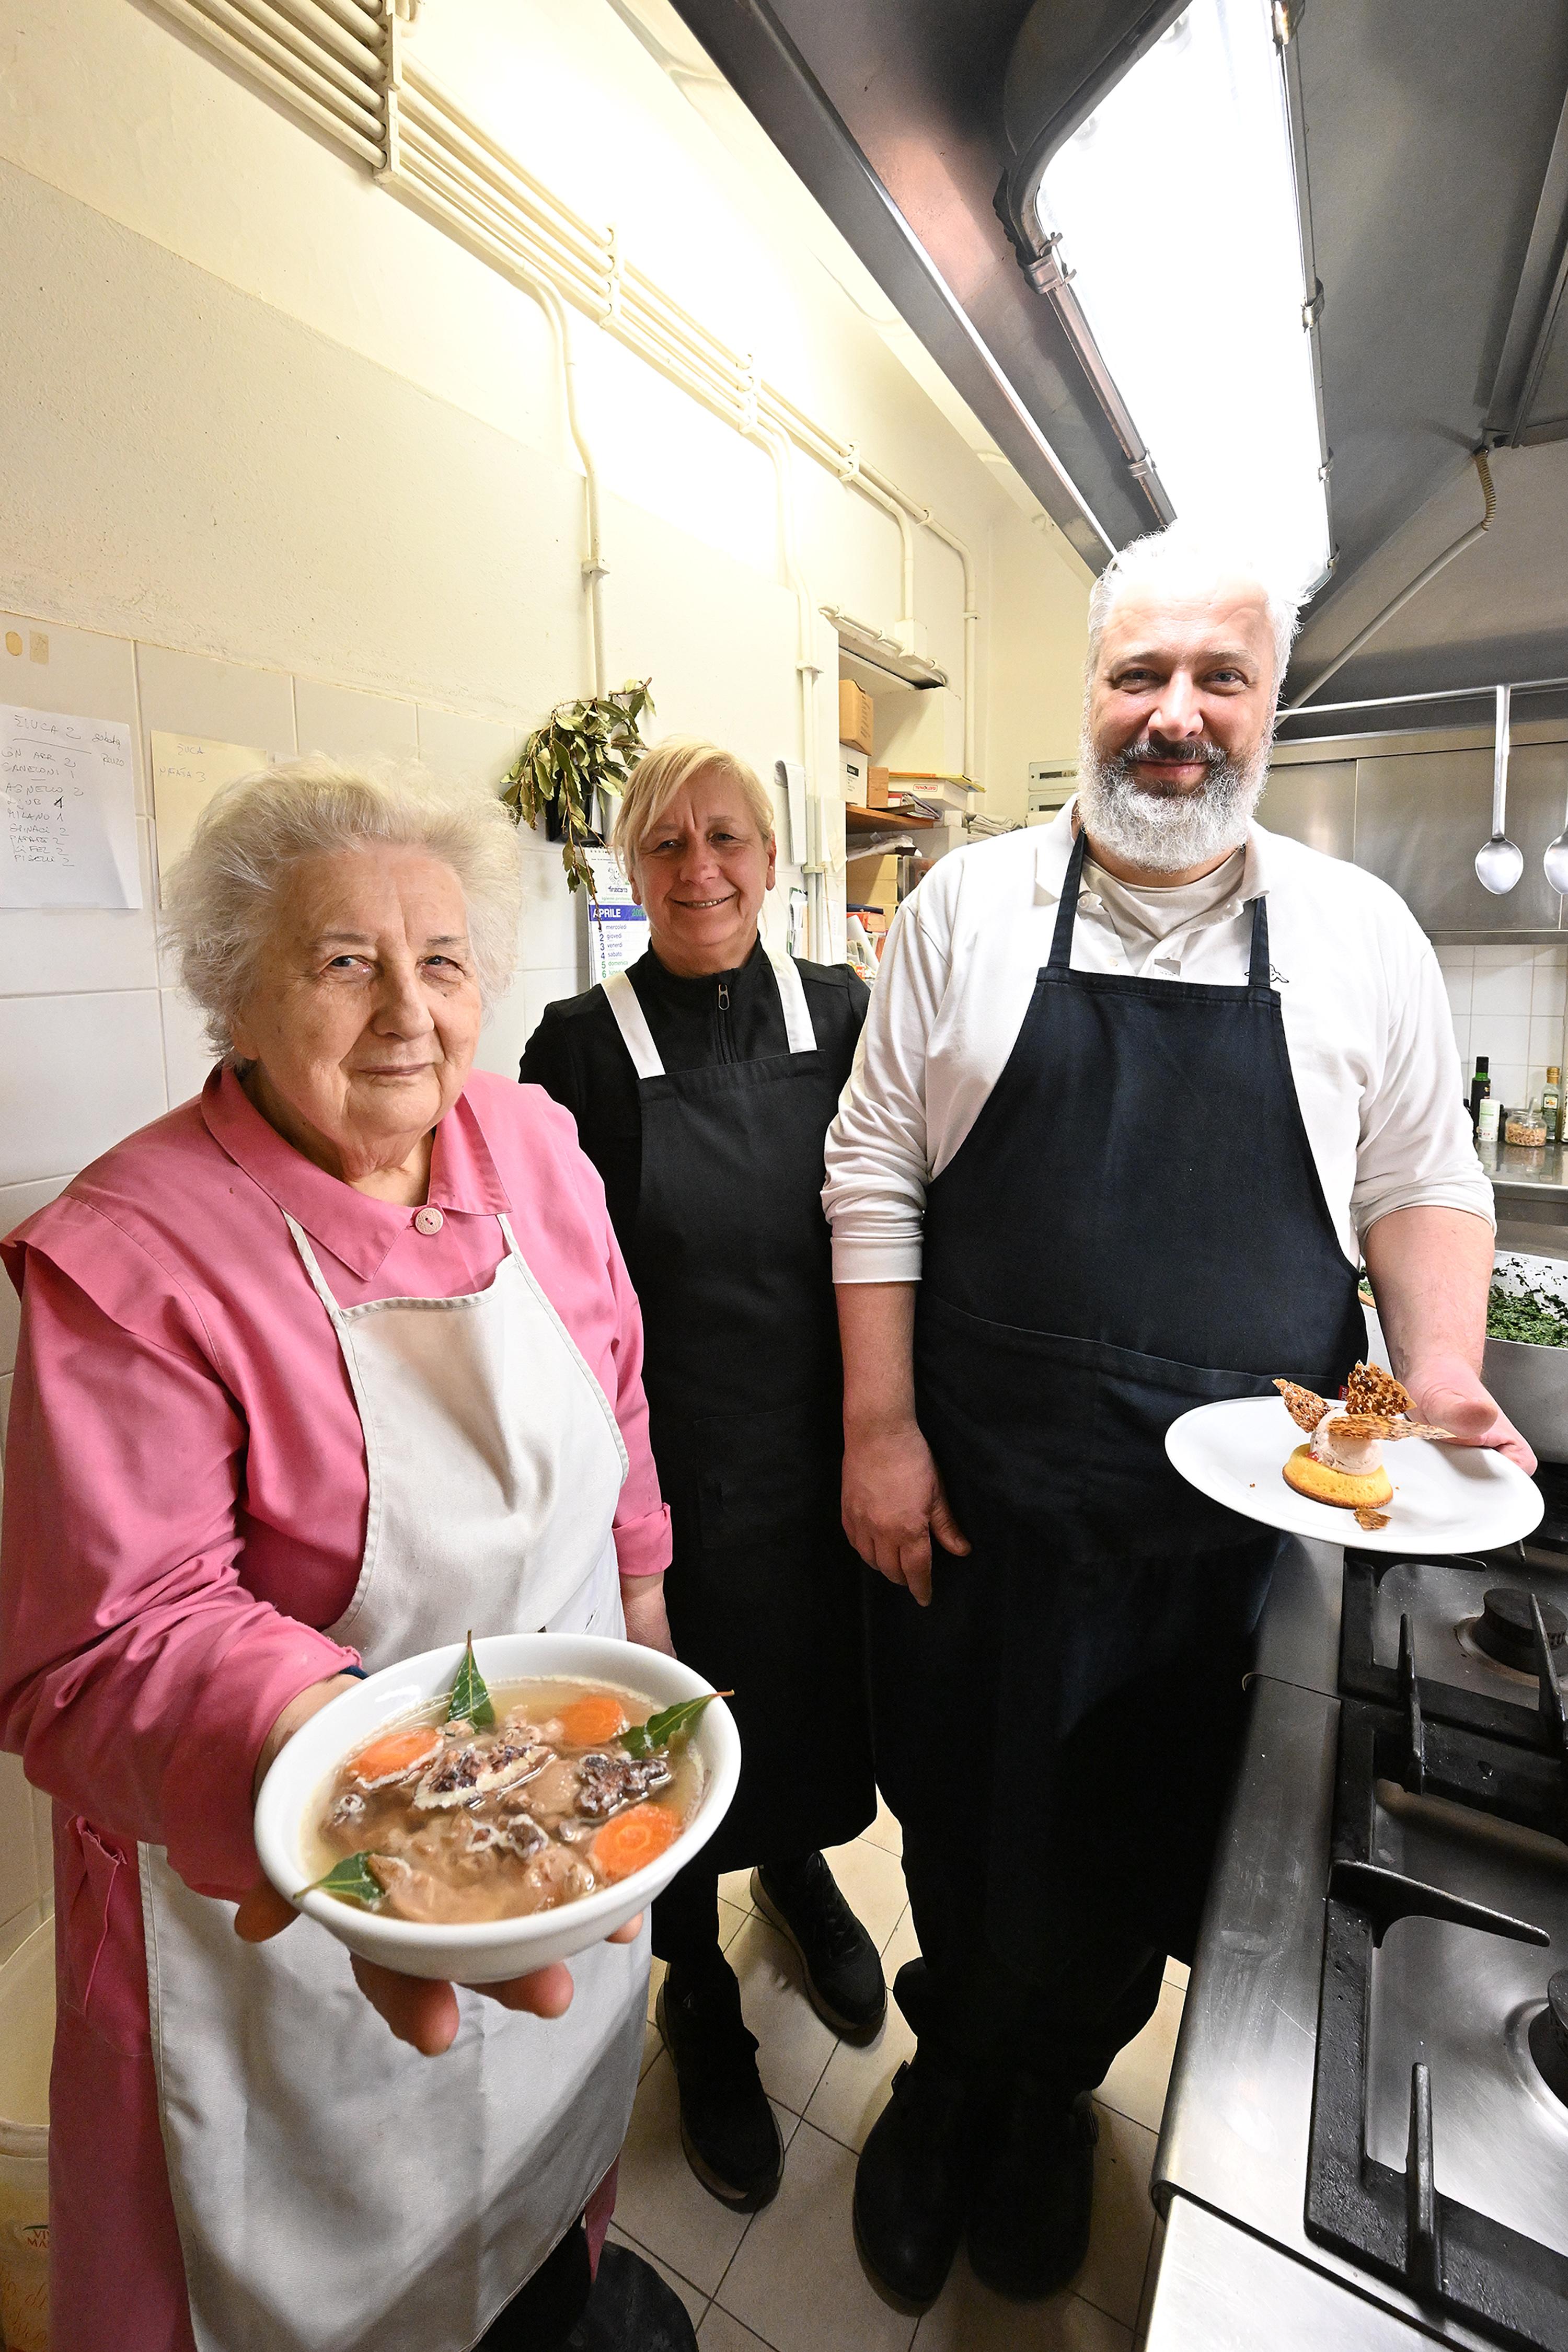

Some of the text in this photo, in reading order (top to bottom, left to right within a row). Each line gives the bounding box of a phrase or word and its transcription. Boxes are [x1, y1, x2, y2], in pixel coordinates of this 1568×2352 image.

[593, 908, 621, 918] APRILE
[599, 933, 604, 942] 2
[600, 942, 605, 951] 3
[602, 961, 606, 969] 5
[602, 970, 607, 978] 6
